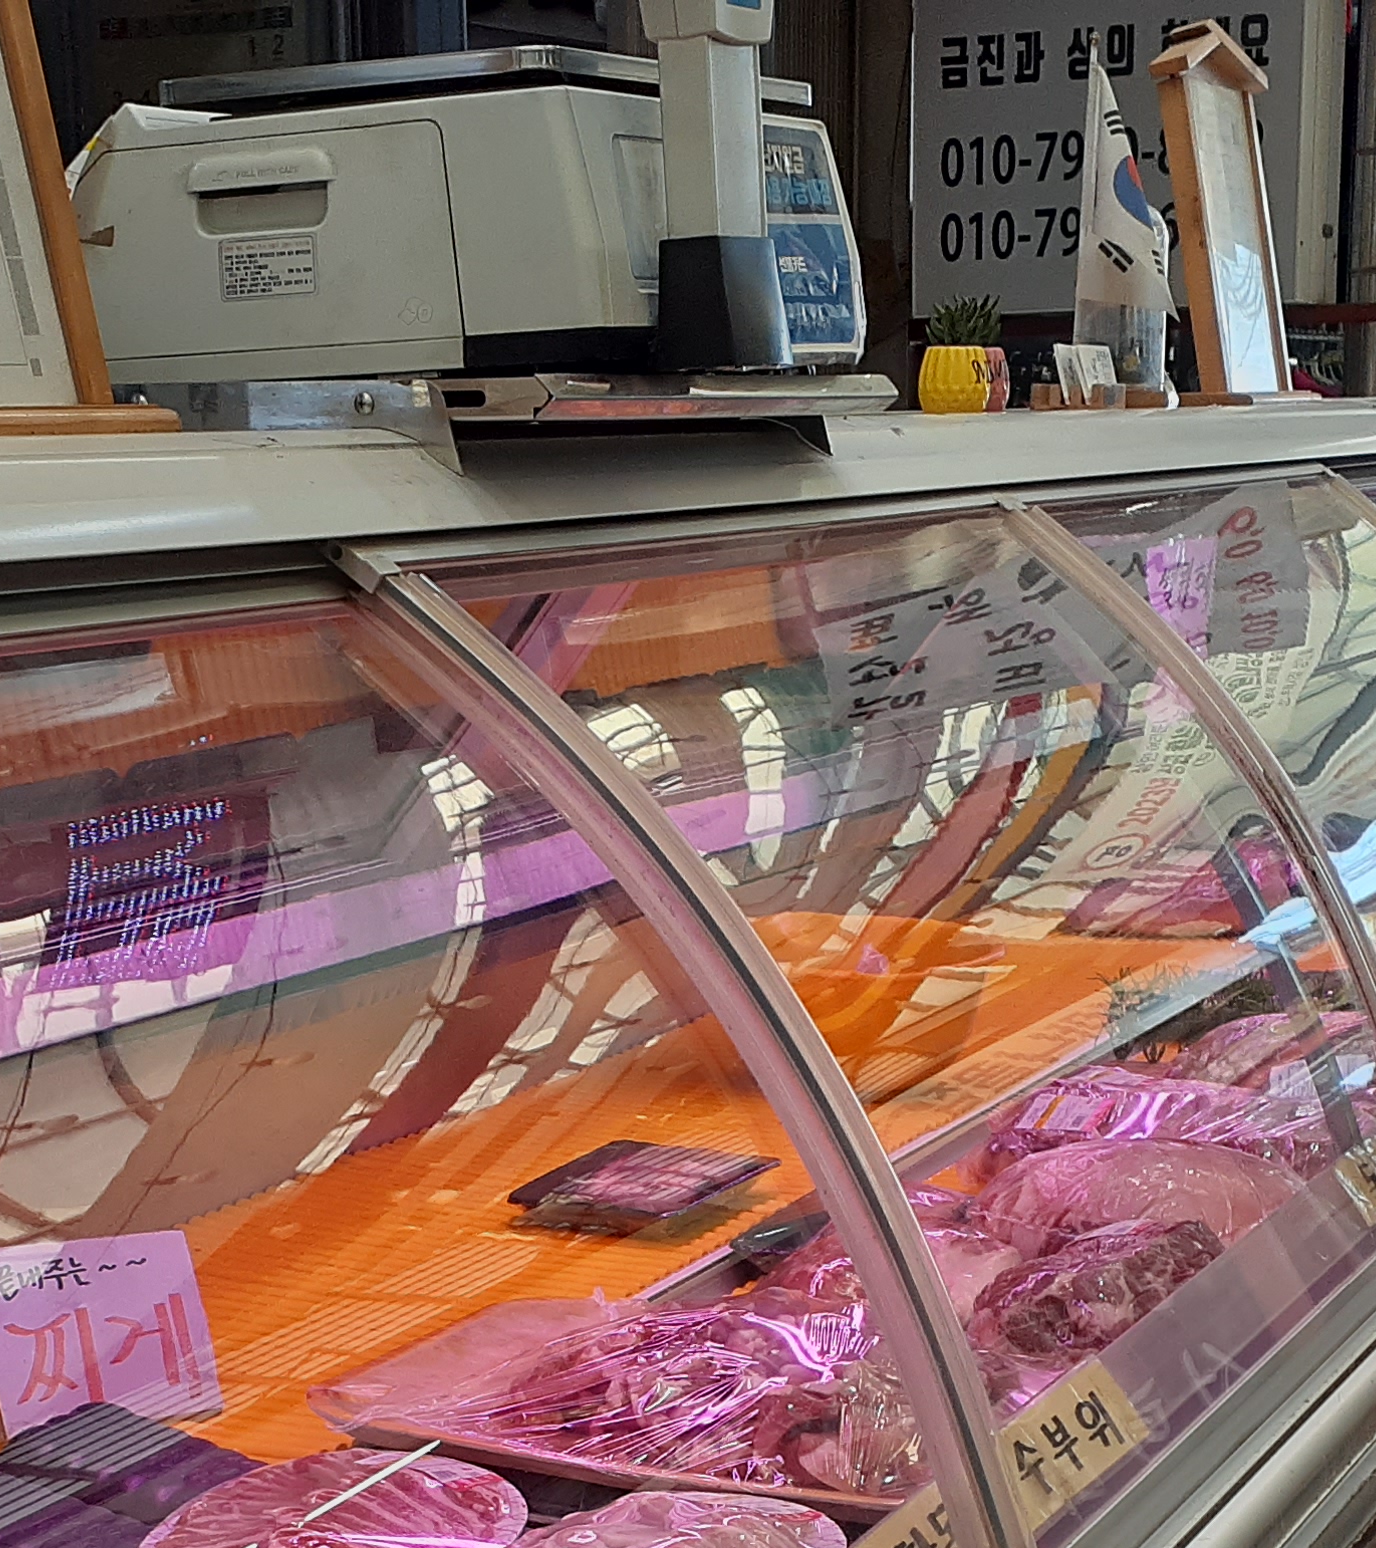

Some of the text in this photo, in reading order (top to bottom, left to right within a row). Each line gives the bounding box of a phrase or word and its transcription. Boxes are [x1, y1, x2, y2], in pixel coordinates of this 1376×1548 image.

[940, 31, 1045, 89] 금진과
[1067, 23, 1135, 80] 상의
[3, 1292, 204, 1405] 찌게
